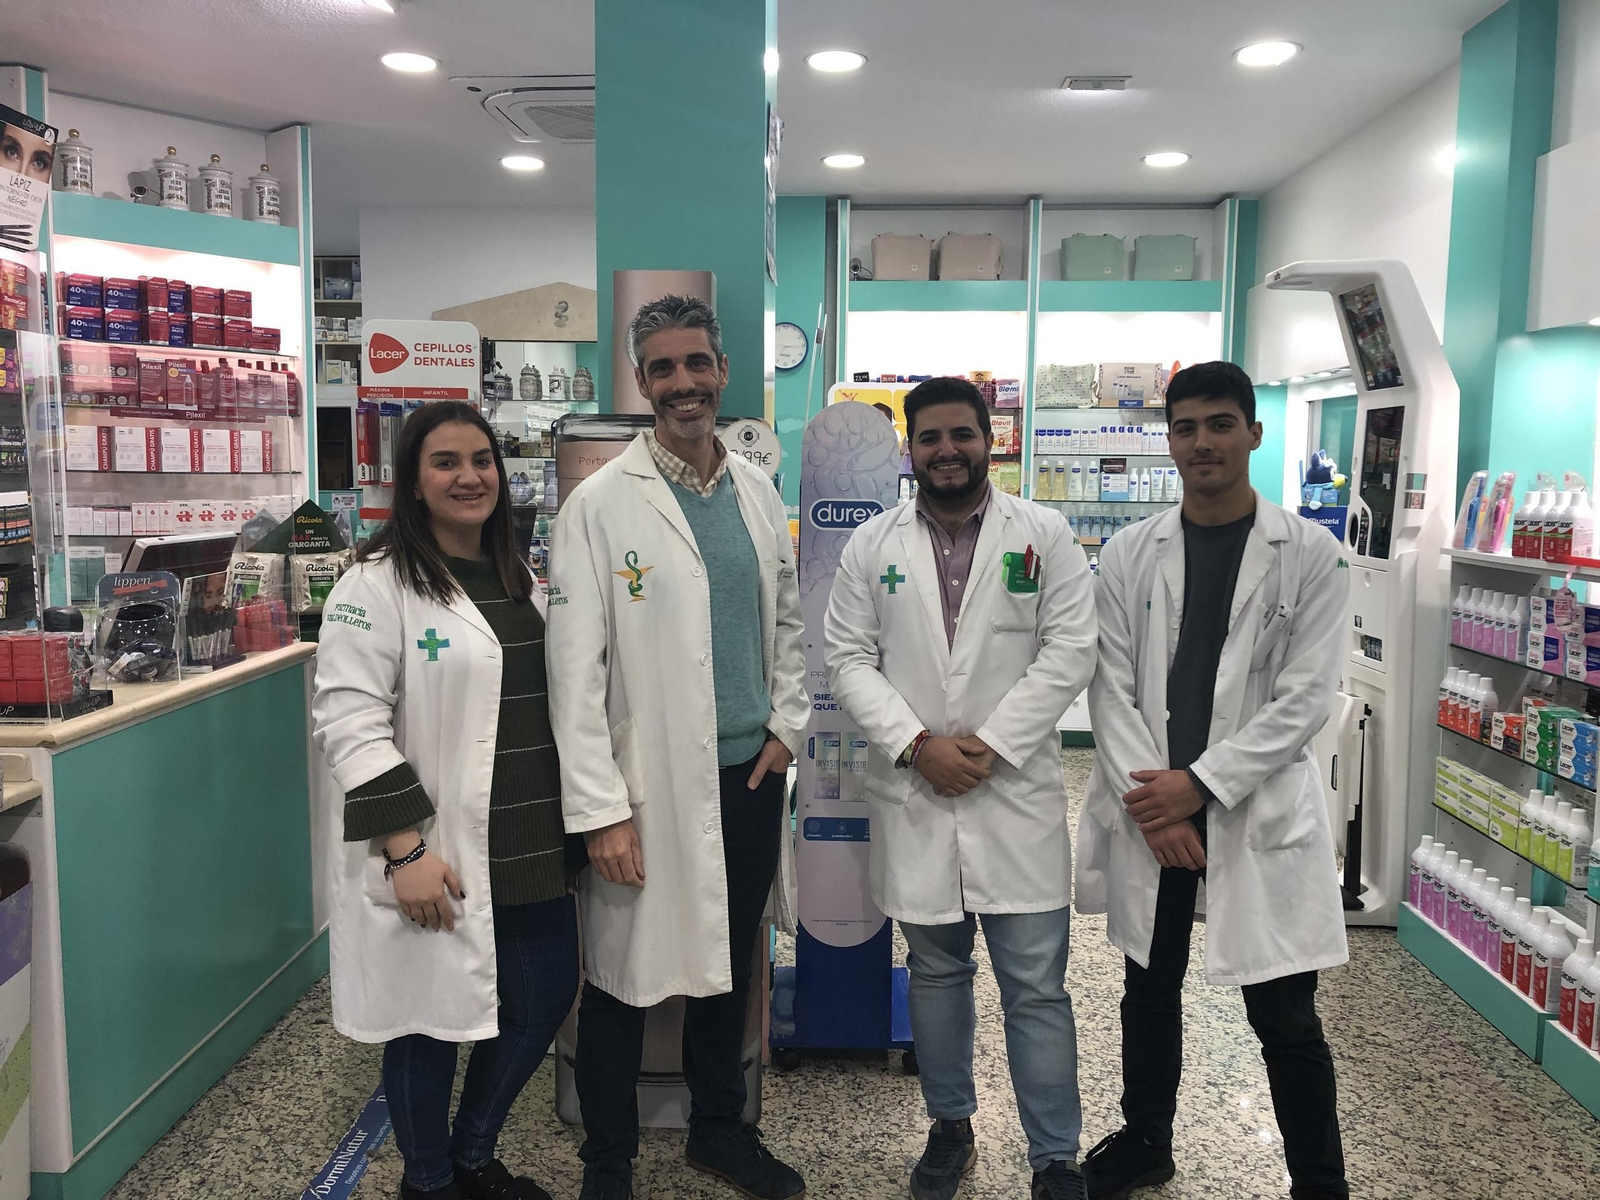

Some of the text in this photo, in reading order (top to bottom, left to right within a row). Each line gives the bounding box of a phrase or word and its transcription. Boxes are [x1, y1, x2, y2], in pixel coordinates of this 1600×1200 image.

[10, 174, 32, 192] LÁPIZ
[414, 343, 472, 353] CEPILLOS
[371, 348, 405, 359] Lacer
[414, 357, 475, 367] DENTALES
[816, 504, 878, 524] durex
[296, 516, 322, 524] Ricola
[234, 562, 265, 571] Ricola
[306, 564, 334, 572] Ricola
[114, 577, 150, 588] lippen
[1562, 723, 1574, 732] Lacer
[1527, 729, 1537, 737] Lacer
[1562, 742, 1573, 750] Lacer
[1526, 747, 1536, 755] Lacer
[1560, 761, 1572, 770] Lacer
[315, 1130, 368, 1194] DormiNatur
